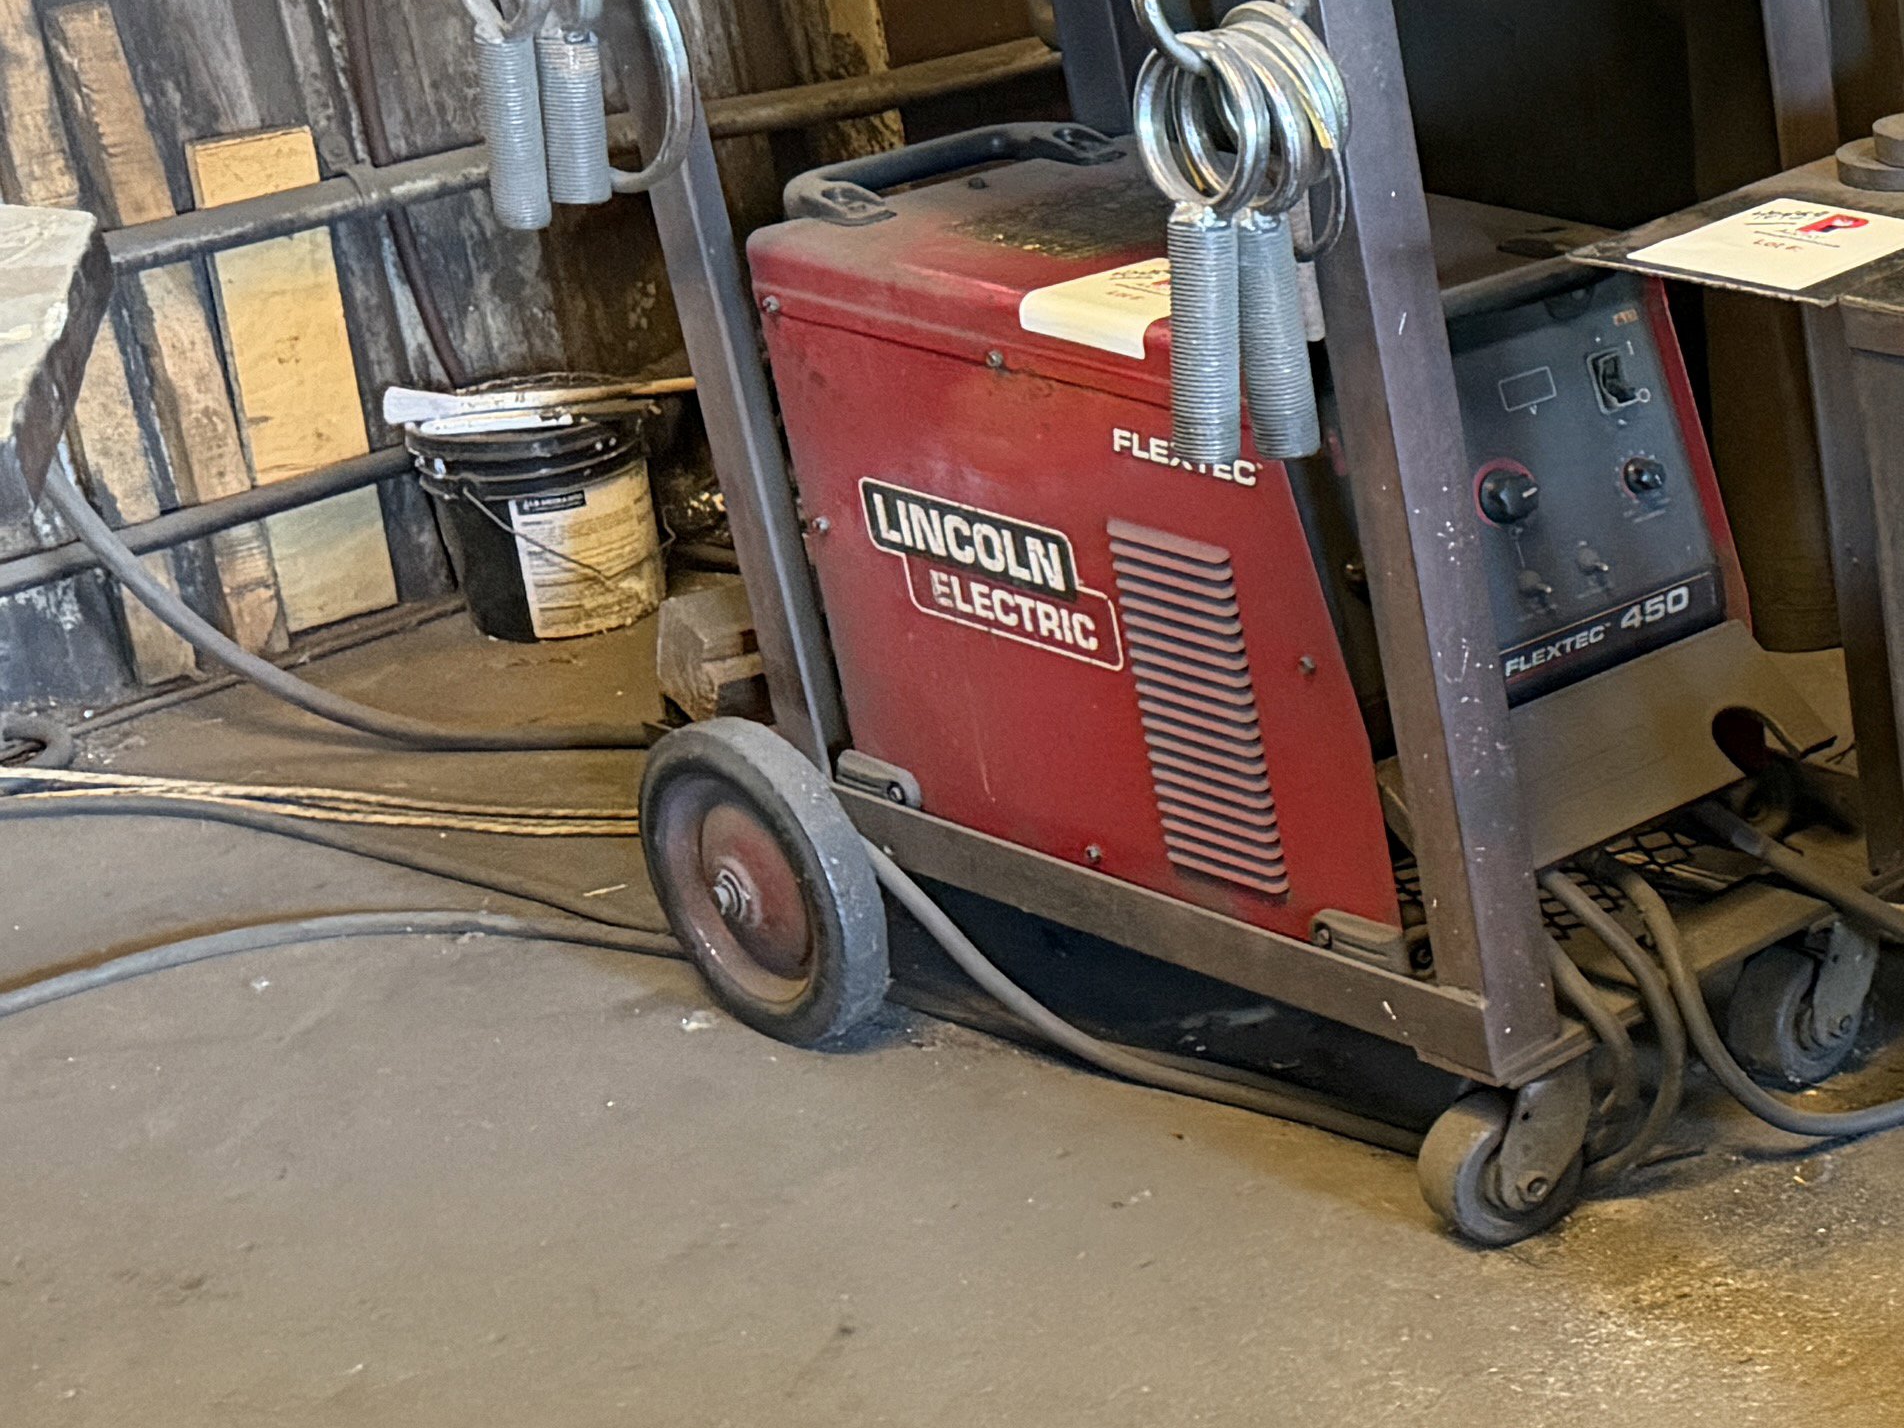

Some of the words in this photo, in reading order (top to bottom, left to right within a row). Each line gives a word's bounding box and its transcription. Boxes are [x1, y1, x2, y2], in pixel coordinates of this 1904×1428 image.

[872, 492, 1067, 592] LINCOLN
[929, 568, 1099, 652] ELECTRIC
[1505, 625, 1606, 677] FLEXTEC
[1620, 586, 1690, 629] 450
